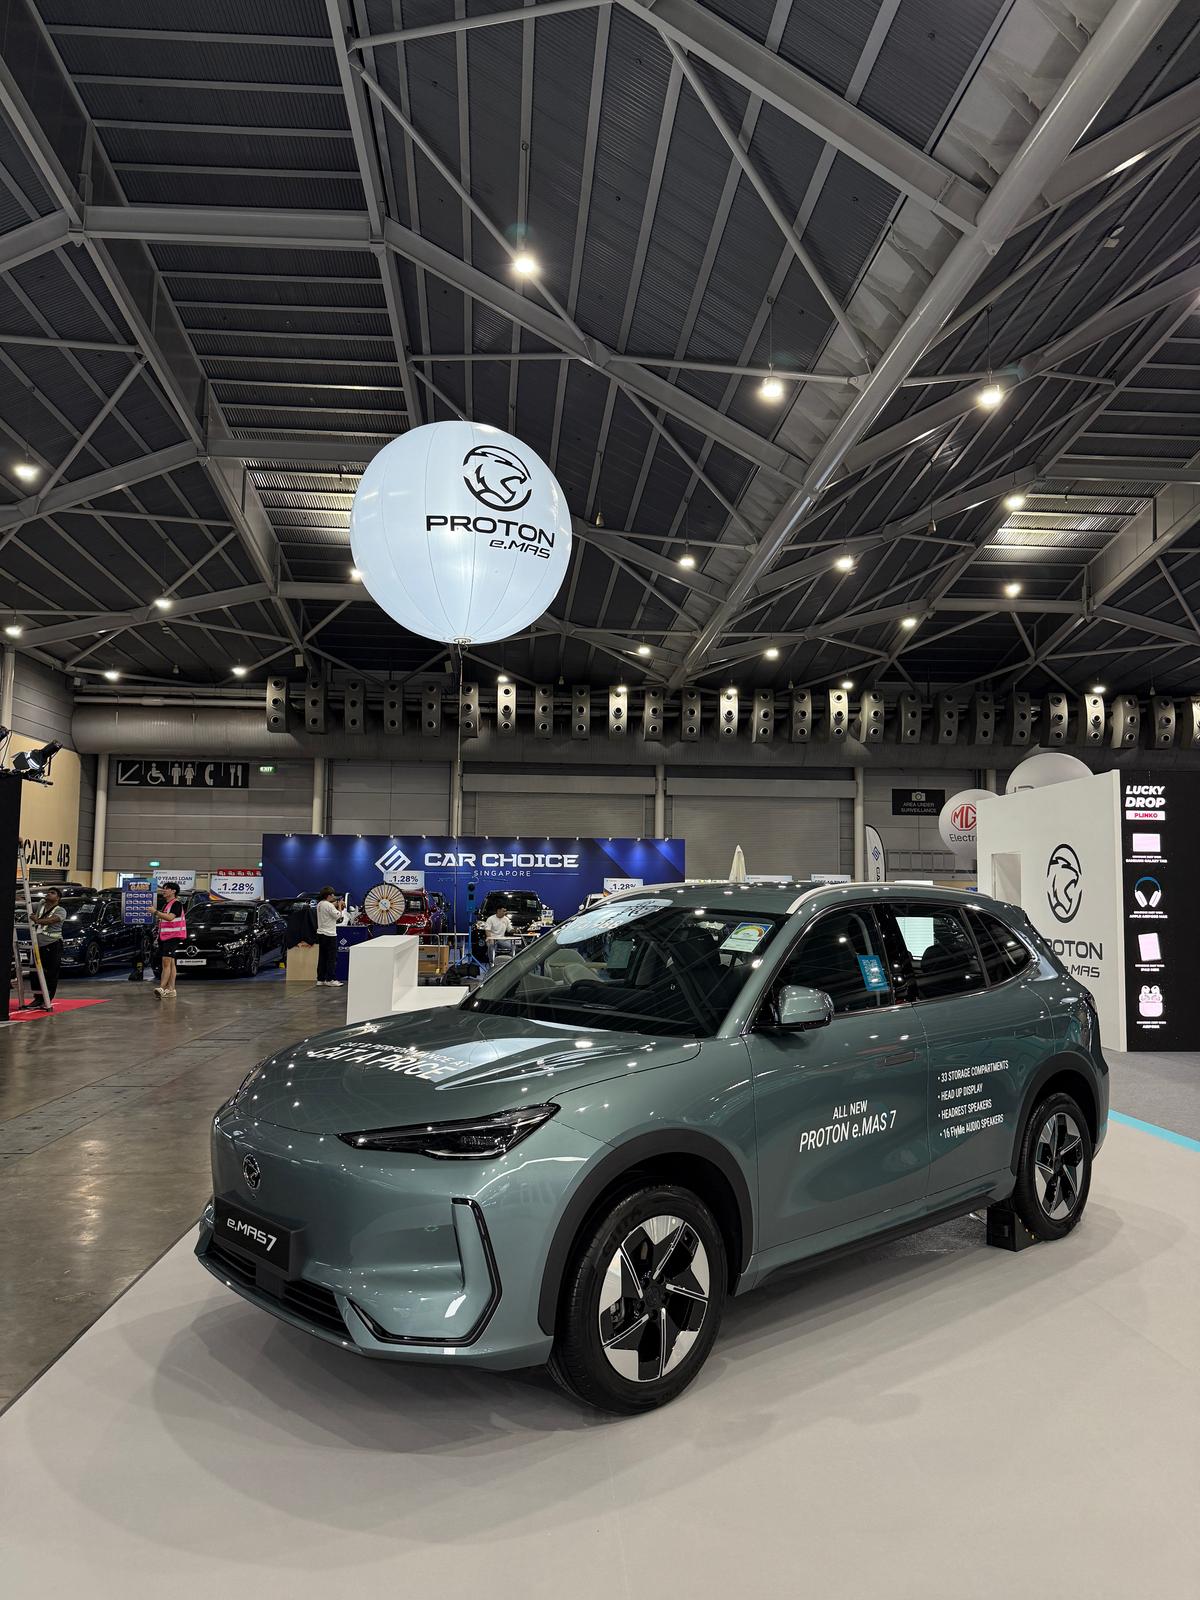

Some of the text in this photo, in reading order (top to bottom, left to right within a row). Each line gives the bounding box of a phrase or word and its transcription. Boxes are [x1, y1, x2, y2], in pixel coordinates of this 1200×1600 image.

[426, 515, 555, 548] PROTON
[489, 539, 551, 560] e.MAS
[1125, 785, 1166, 795] LUCKY
[1125, 796, 1166, 808] DROP
[953, 806, 977, 829] MG
[23, 838, 70, 867] CAFE 4B
[424, 852, 580, 868] CAR CHOICE
[392, 875, 419, 883] 1.28%
[473, 870, 531, 878] SINGAPORE
[222, 882, 255, 892] 1.28%
[354, 1051, 387, 1065] A
[379, 1053, 458, 1079] PRICE
[941, 1060, 1009, 1082] 33 STORAGE COMPARTMENTS
[941, 1083, 983, 1101] HEAD UP DISPLAY
[832, 1100, 868, 1120] ALL NEW
[941, 1099, 992, 1120] HEADREST SPEAKERS
[799, 1110, 897, 1153] PROTON e.MAS 7
[943, 1128, 950, 1139] 16
[965, 1120, 981, 1132] AUDIO
[980, 1114, 1004, 1129] SPEAKERS
